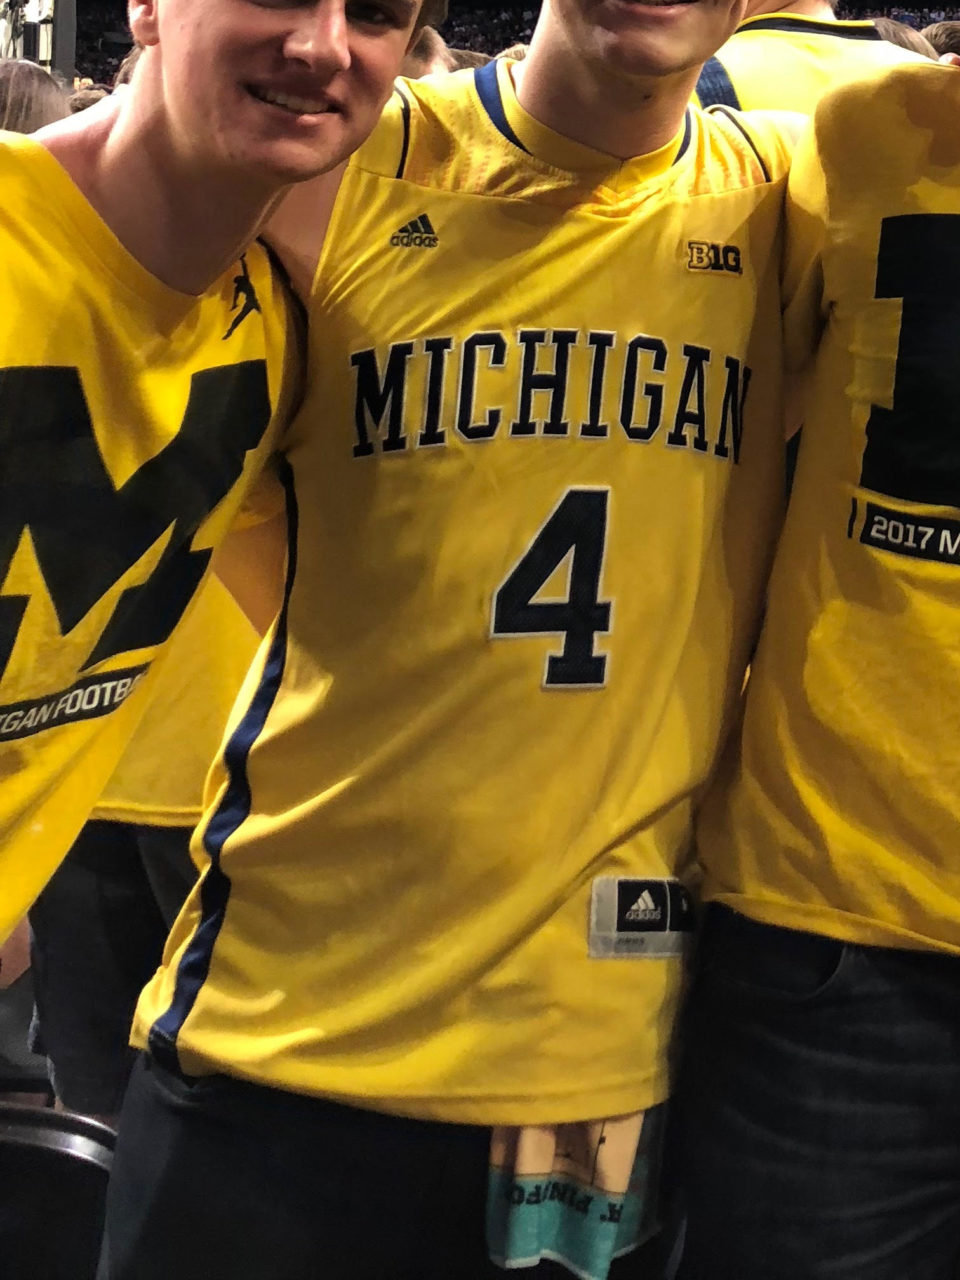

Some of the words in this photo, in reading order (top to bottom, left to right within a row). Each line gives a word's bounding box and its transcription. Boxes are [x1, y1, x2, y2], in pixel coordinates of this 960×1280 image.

[390, 231, 439, 248] adidas
[351, 329, 752, 464] MICHIGAN
[870, 514, 935, 550] 2017
[489, 484, 616, 690] 4
[625, 907, 662, 920] adidas
